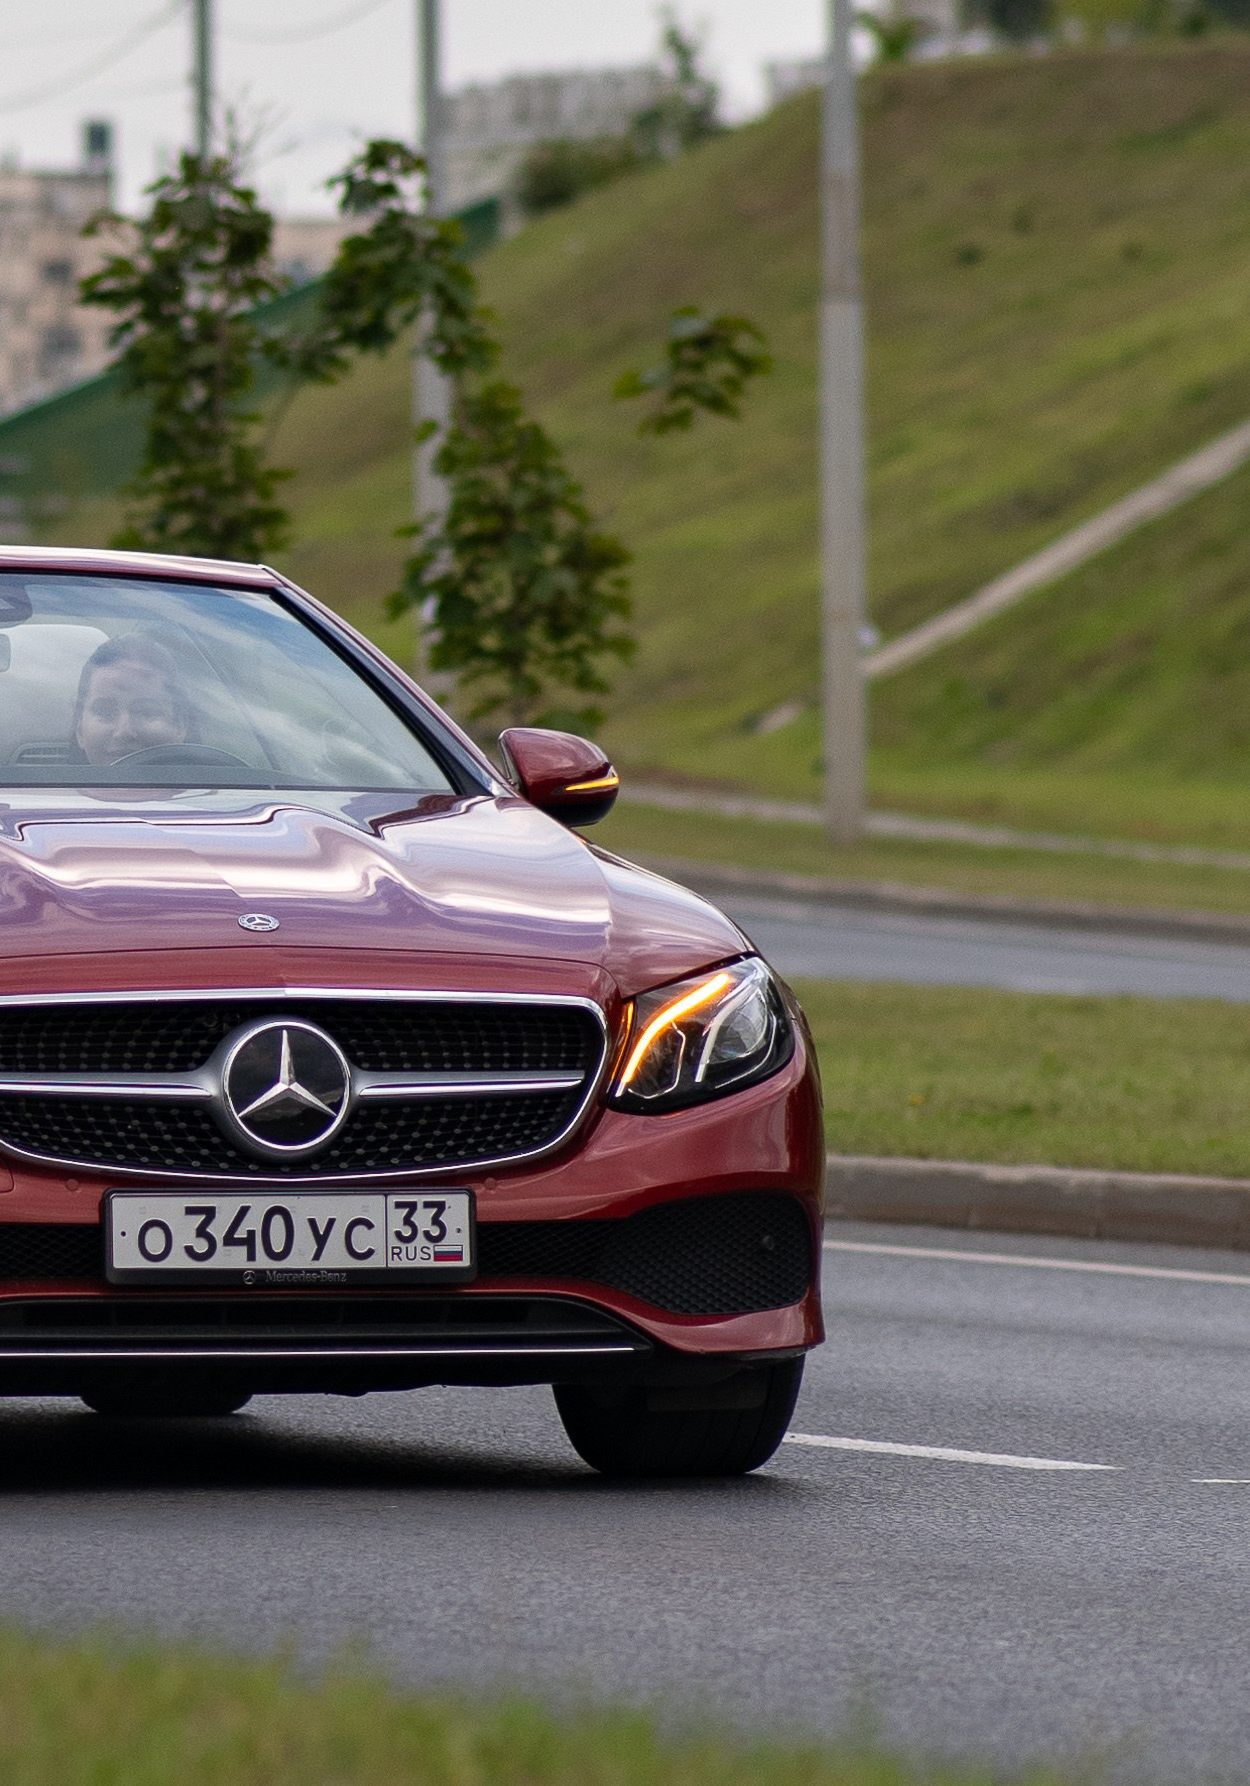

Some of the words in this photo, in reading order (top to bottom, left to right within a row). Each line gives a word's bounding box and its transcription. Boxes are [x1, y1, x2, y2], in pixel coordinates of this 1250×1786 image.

[394, 1200, 447, 1244] 33
[391, 1245, 432, 1261] RUS
[265, 1270, 347, 1283] Mercedes-Benz
